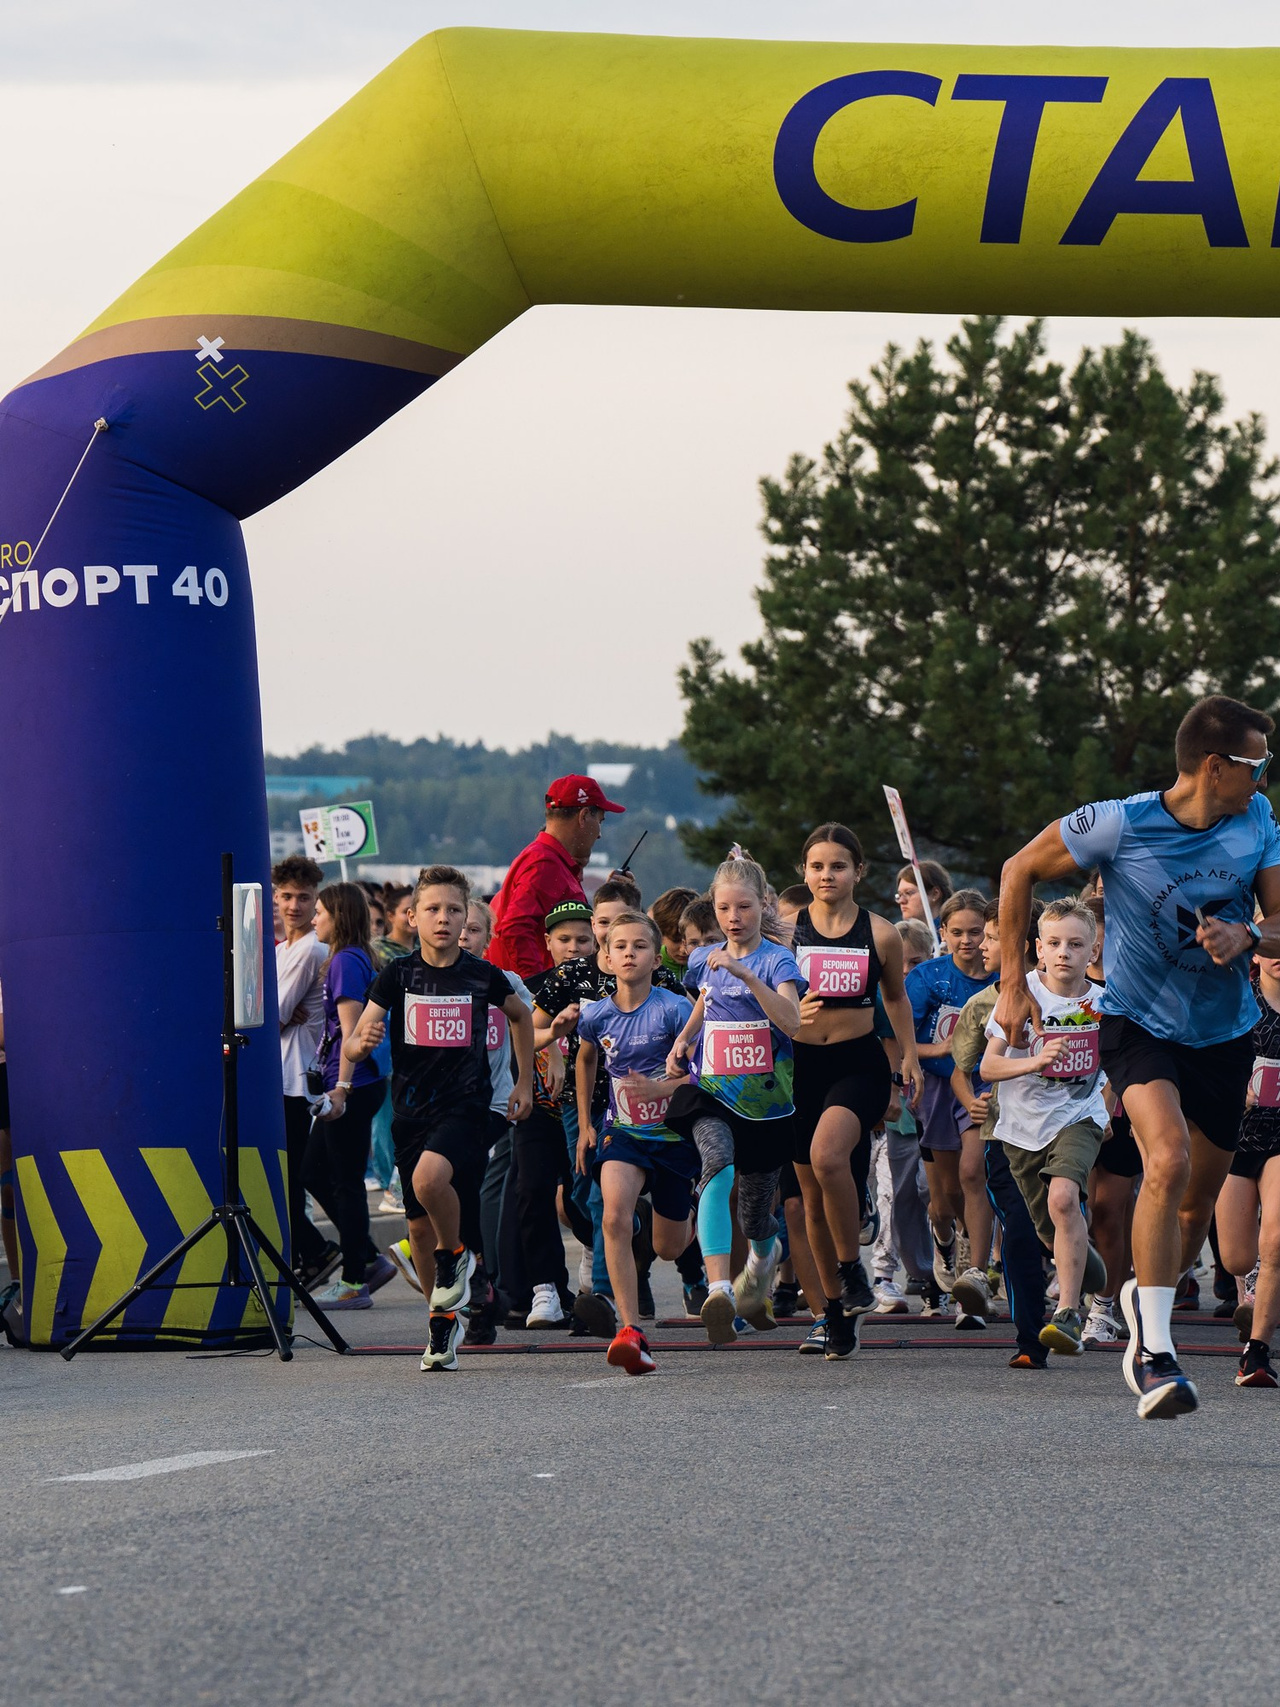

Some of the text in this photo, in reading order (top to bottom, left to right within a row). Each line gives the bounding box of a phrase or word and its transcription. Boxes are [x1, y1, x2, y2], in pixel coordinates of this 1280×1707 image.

[171, 565, 229, 607] 40
[822, 959, 859, 970] ВЕРОНИКА
[818, 971, 861, 993] 2035
[429, 1006, 460, 1018] ЕВГЕНИЙ
[426, 1019, 466, 1041] 1529
[728, 1033, 754, 1044] МАРИЯ
[1068, 1039, 1089, 1049] ИКИТА
[723, 1045, 766, 1068] 1632
[637, 1096, 673, 1121] 324
